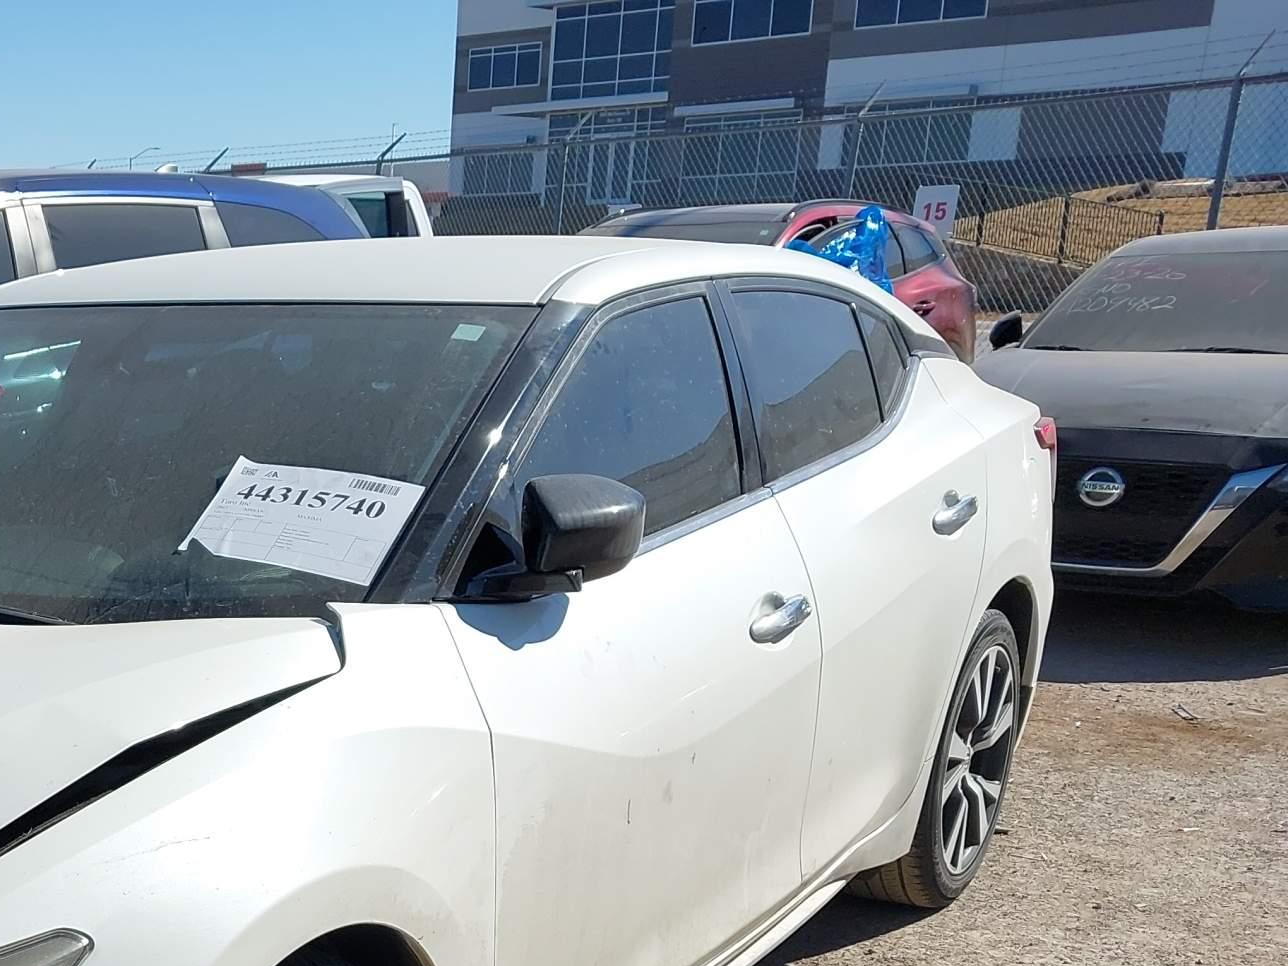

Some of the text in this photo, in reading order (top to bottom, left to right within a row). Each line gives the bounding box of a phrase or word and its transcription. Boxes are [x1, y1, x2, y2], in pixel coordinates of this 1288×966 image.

[923, 201, 947, 221] 15
[1081, 482, 1119, 491] NISSAN
[236, 483, 386, 519] 44315740
